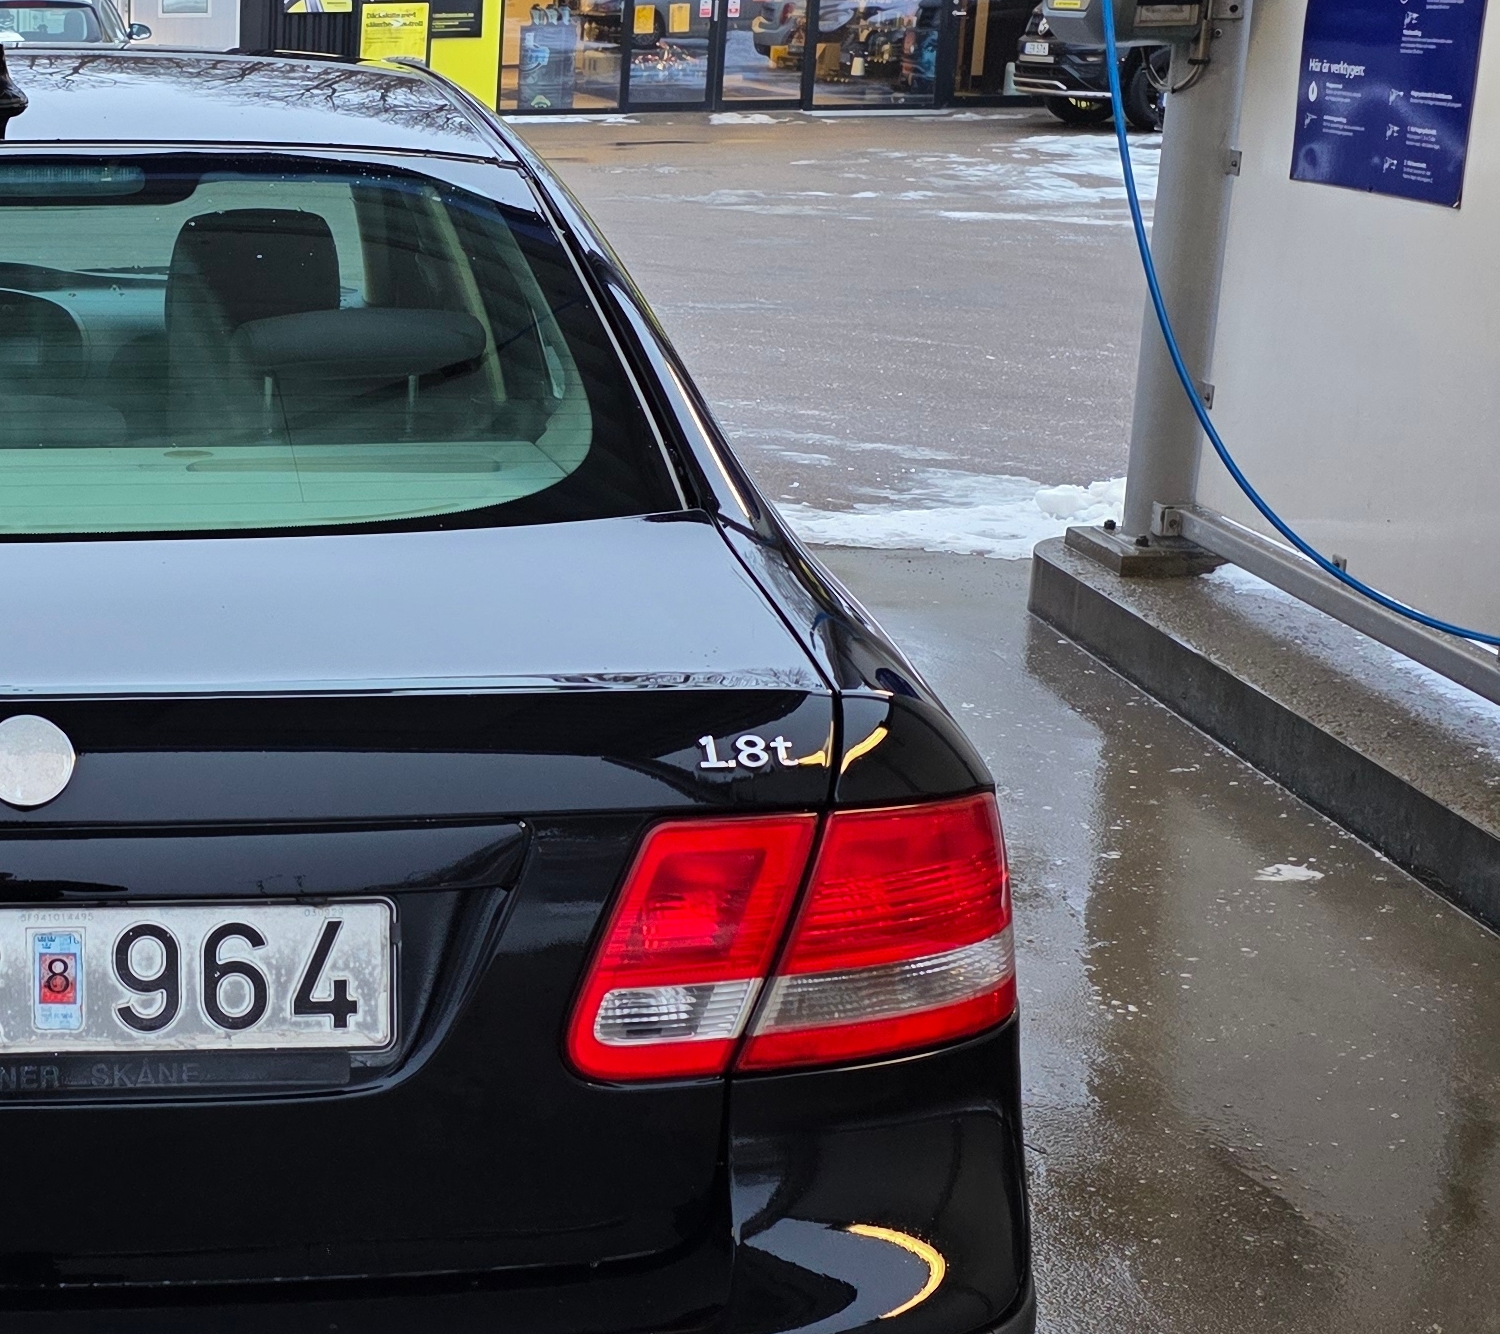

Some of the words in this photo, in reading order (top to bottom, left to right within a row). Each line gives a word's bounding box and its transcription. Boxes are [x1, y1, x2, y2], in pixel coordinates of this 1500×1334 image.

[699, 734, 799, 768] 1.8t
[47, 958, 70, 994] 8
[114, 920, 358, 1032] 964
[91, 1058, 200, 1088] SKÅNE
